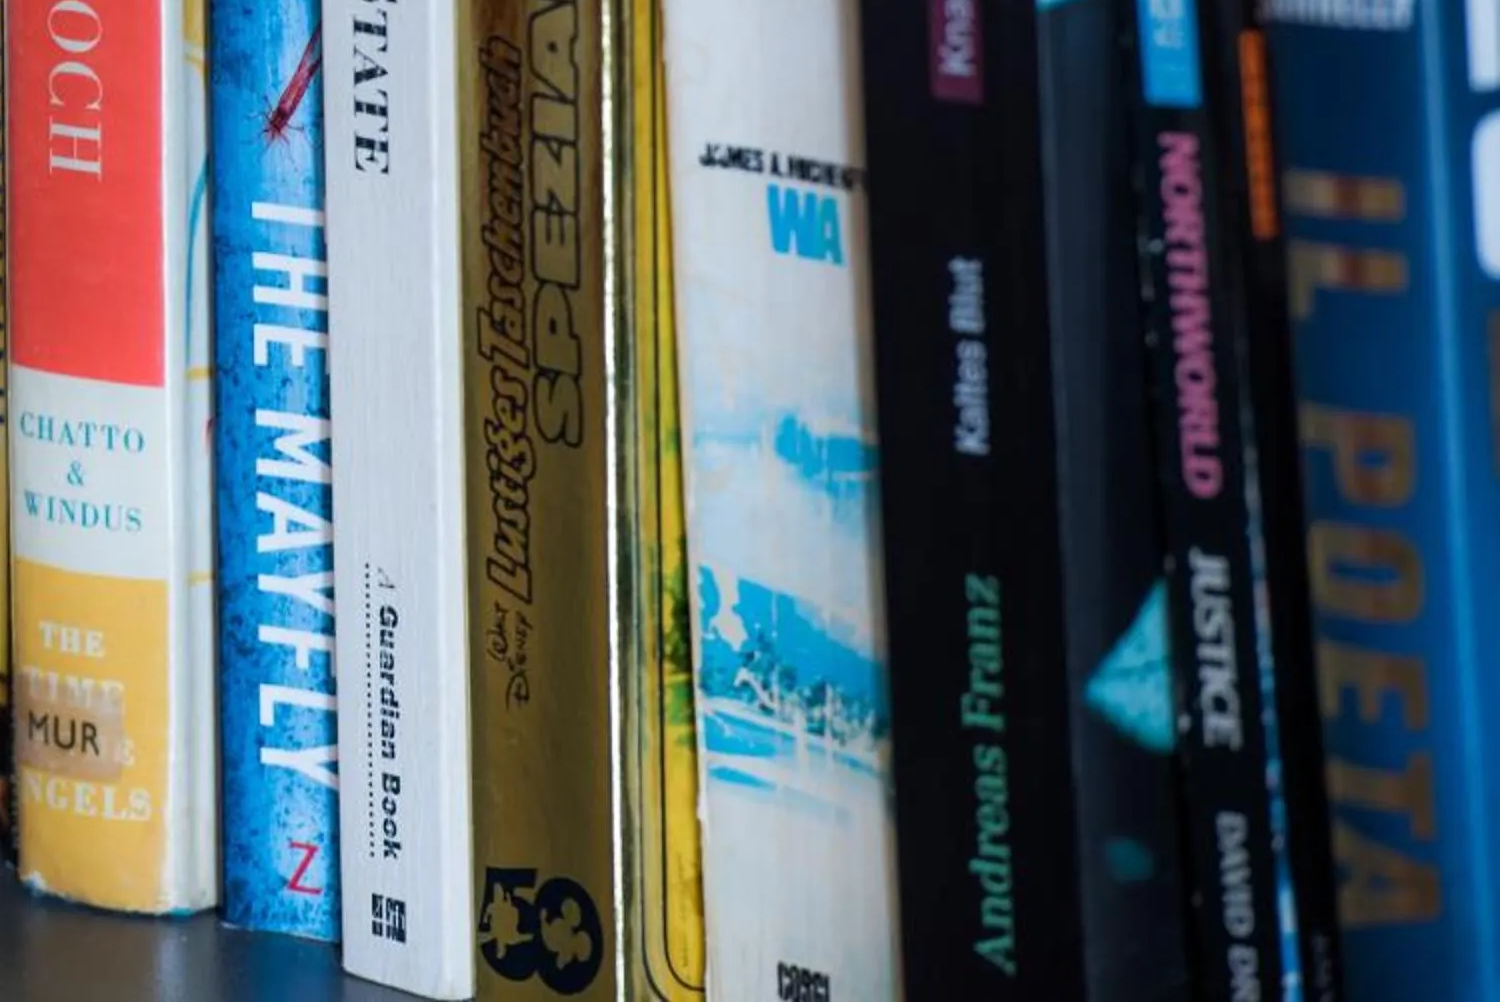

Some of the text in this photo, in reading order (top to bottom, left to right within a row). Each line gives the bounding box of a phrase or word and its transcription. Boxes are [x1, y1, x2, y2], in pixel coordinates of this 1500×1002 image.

[476, 33, 531, 373] Taschenbuch
[697, 142, 765, 174] JAMES
[766, 182, 844, 266] WA
[947, 254, 991, 457] Kaltes Blut
[1156, 131, 1224, 499] NORTHWORLD
[18, 411, 146, 455] CHATTO
[65, 460, 85, 488] &
[483, 365, 537, 606] Lustiges
[21, 491, 144, 533] WINDUS
[1285, 166, 1444, 932] IL POETA
[38, 620, 106, 659] THE
[254, 408, 340, 792] MAYFLY
[1188, 546, 1246, 754] JUSTICE
[22, 665, 128, 714] TIME
[27, 709, 102, 757] MUR
[376, 604, 401, 760] Guardian
[379, 772, 402, 861] Book
[960, 572, 1018, 979] Andreas Franz
[285, 841, 323, 897] Z
[1217, 810, 1256, 939] DAVID
